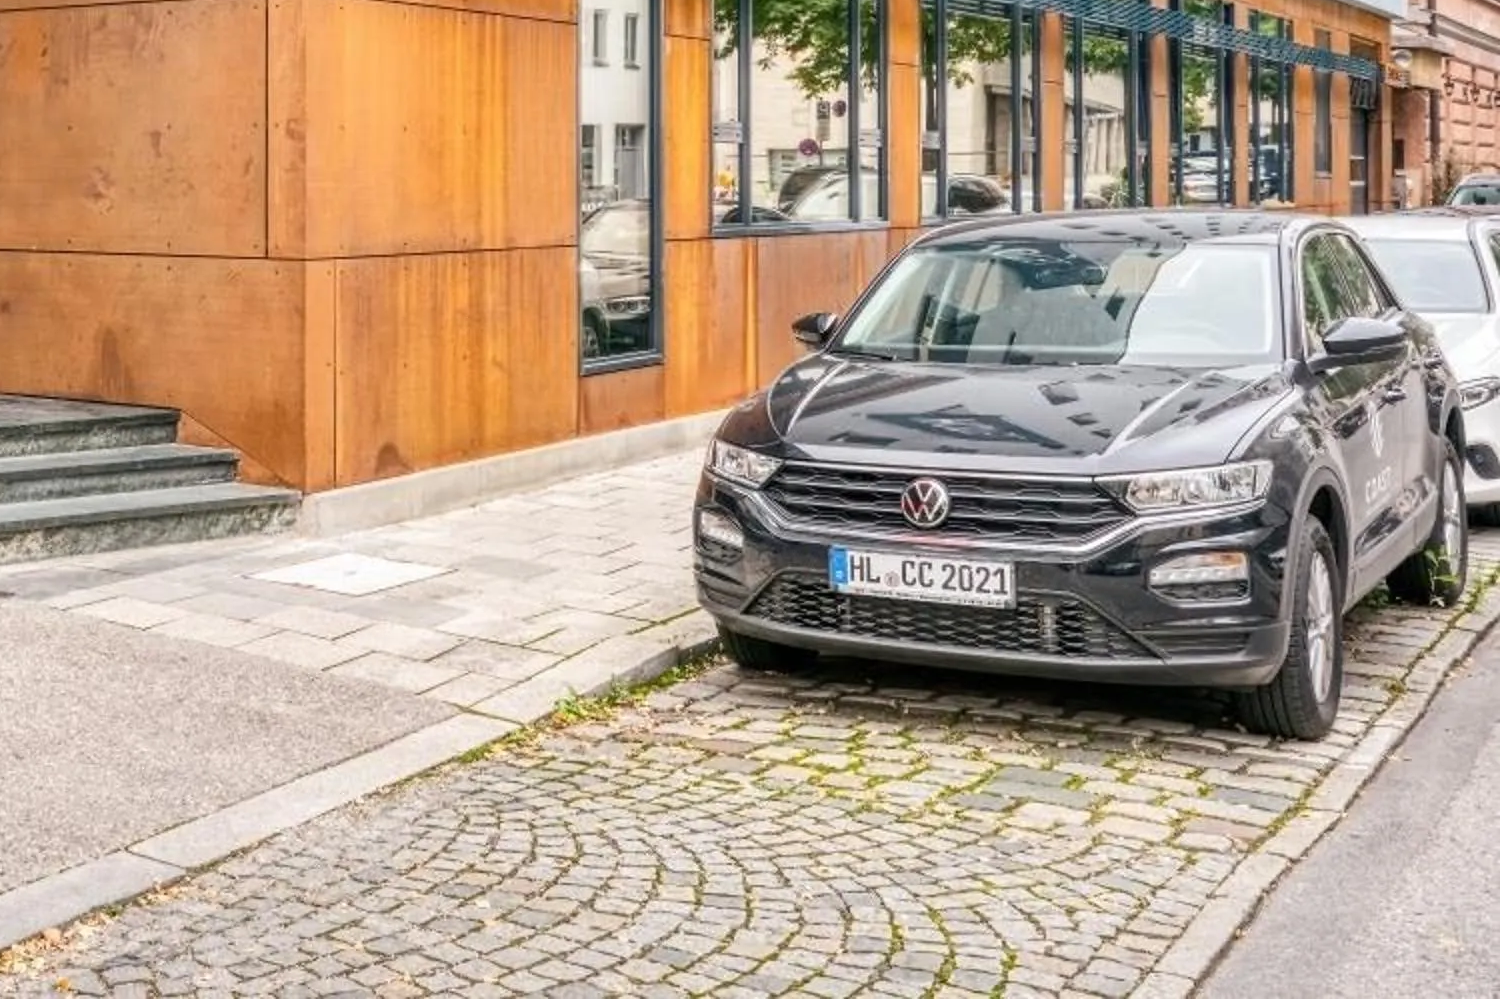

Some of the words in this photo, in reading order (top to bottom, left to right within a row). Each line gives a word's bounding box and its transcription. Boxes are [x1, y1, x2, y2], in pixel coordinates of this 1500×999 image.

[850, 555, 881, 584] HL
[901, 560, 935, 589] CC
[941, 563, 1009, 596] 2021
